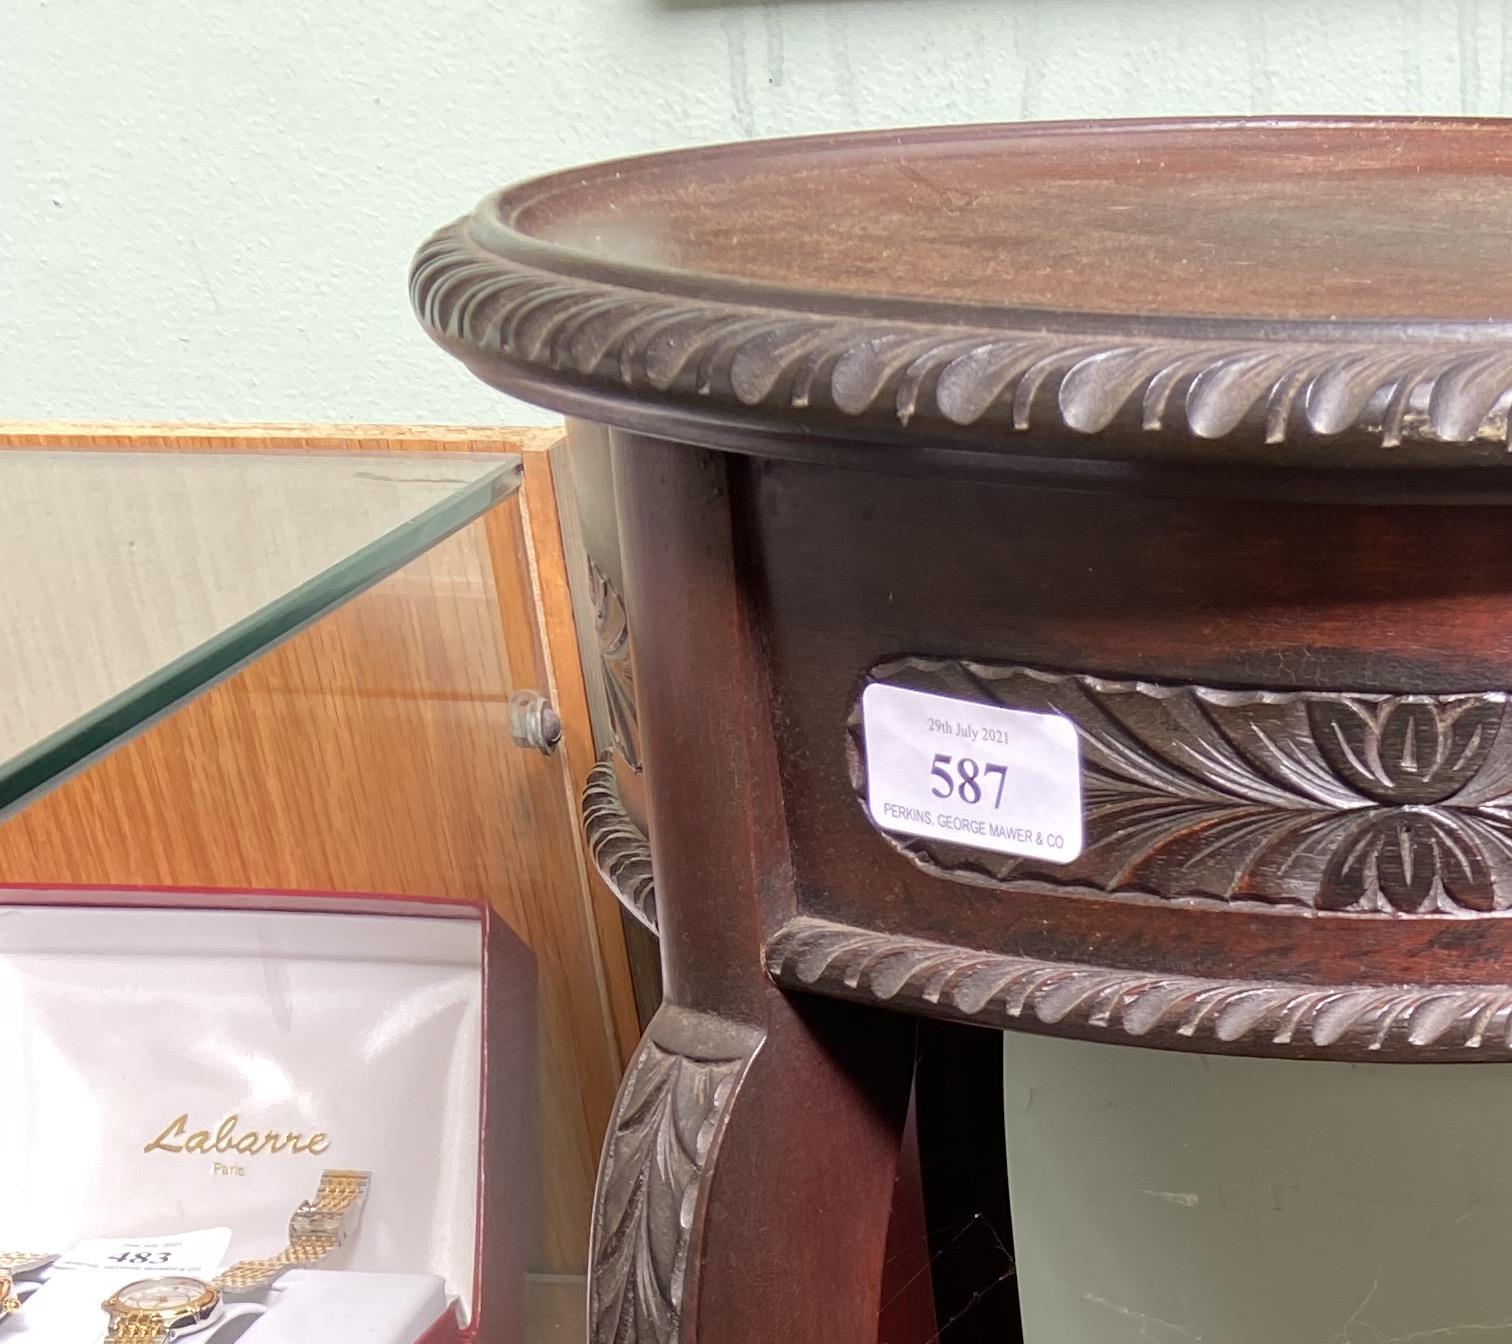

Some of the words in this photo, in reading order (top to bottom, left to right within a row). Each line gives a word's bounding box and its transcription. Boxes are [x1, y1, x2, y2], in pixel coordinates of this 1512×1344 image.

[928, 717, 953, 735] 29th
[955, 723, 978, 741] July
[982, 728, 1010, 745] 2021
[930, 753, 1008, 809] 587
[937, 814, 987, 836] GEORGE
[989, 824, 1033, 844] MAWER
[1035, 832, 1044, 847] &
[1046, 834, 1065, 849] CO
[144, 1113, 332, 1156] Labarre
[108, 1252, 173, 1264] 483
